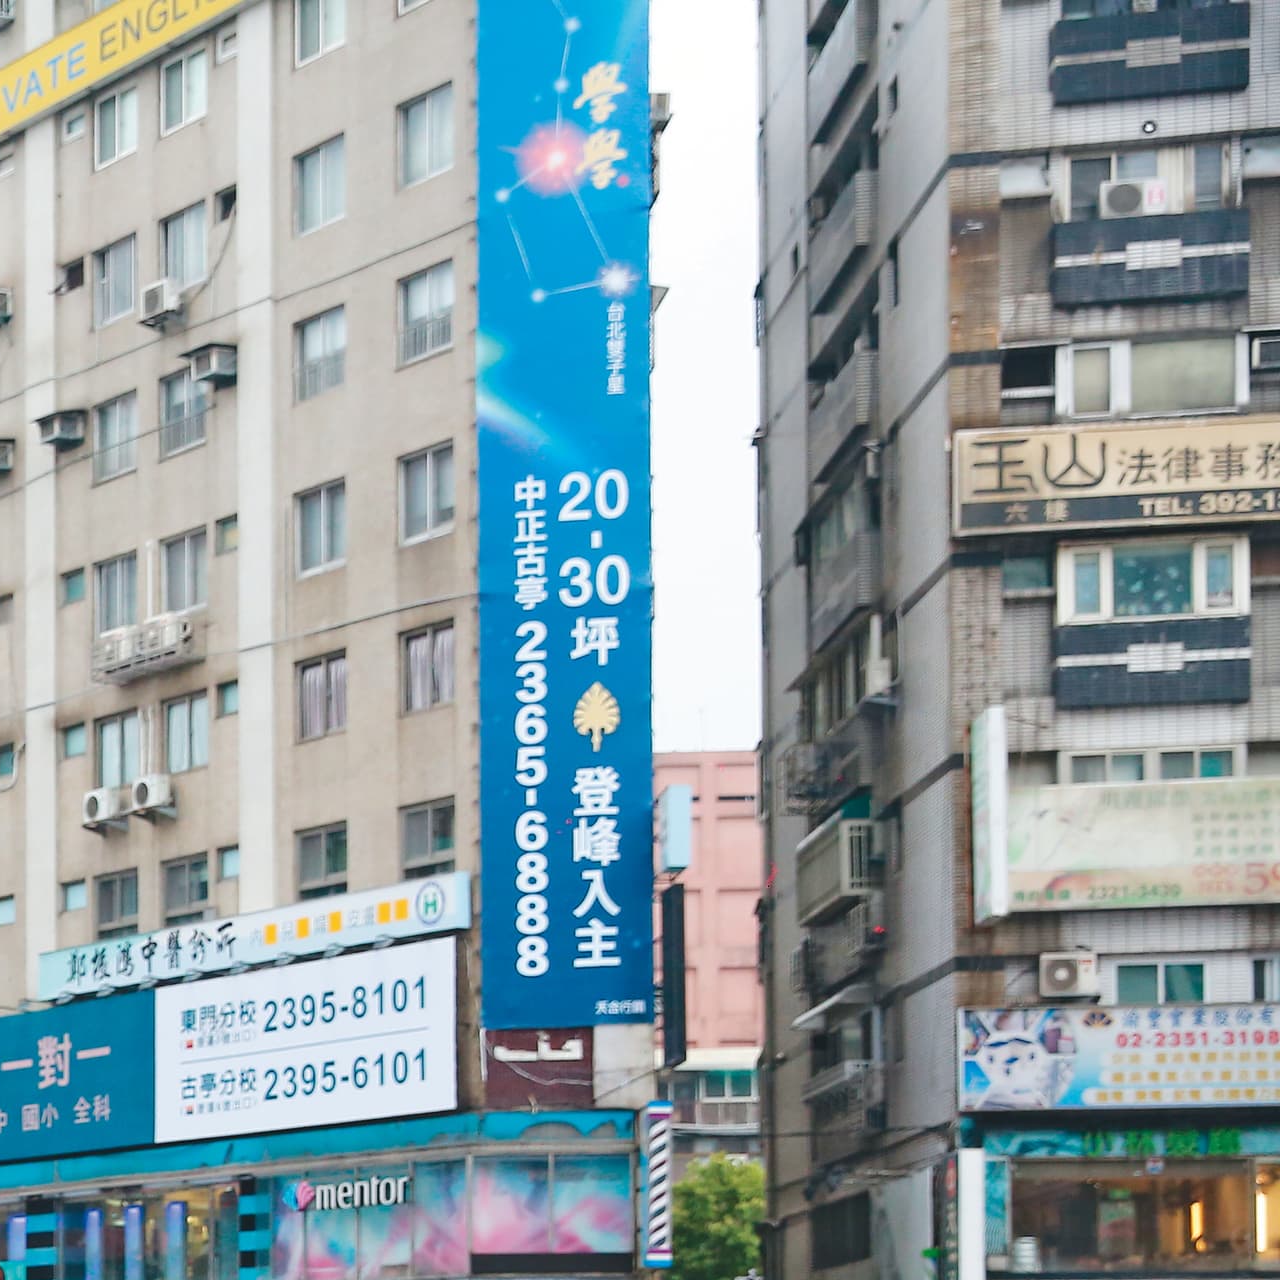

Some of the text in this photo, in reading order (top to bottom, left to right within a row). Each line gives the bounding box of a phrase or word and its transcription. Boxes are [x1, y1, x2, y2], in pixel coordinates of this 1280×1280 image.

[99, 0, 217, 61] ENGL
[1138, 499, 1192, 518] TEL:
[513, 475, 548, 612] 中正古亭
[514, 620, 550, 977] 2365-6888
[571, 767, 622, 968] 登峰入主
[180, 975, 426, 1034] 東門分校 2395-8101
[180, 1047, 426, 1102] 古亭分校 2395-6101
[22, 1102, 59, 1132] 國小
[73, 1094, 112, 1124] 全科
[315, 1175, 411, 1211] mentor
